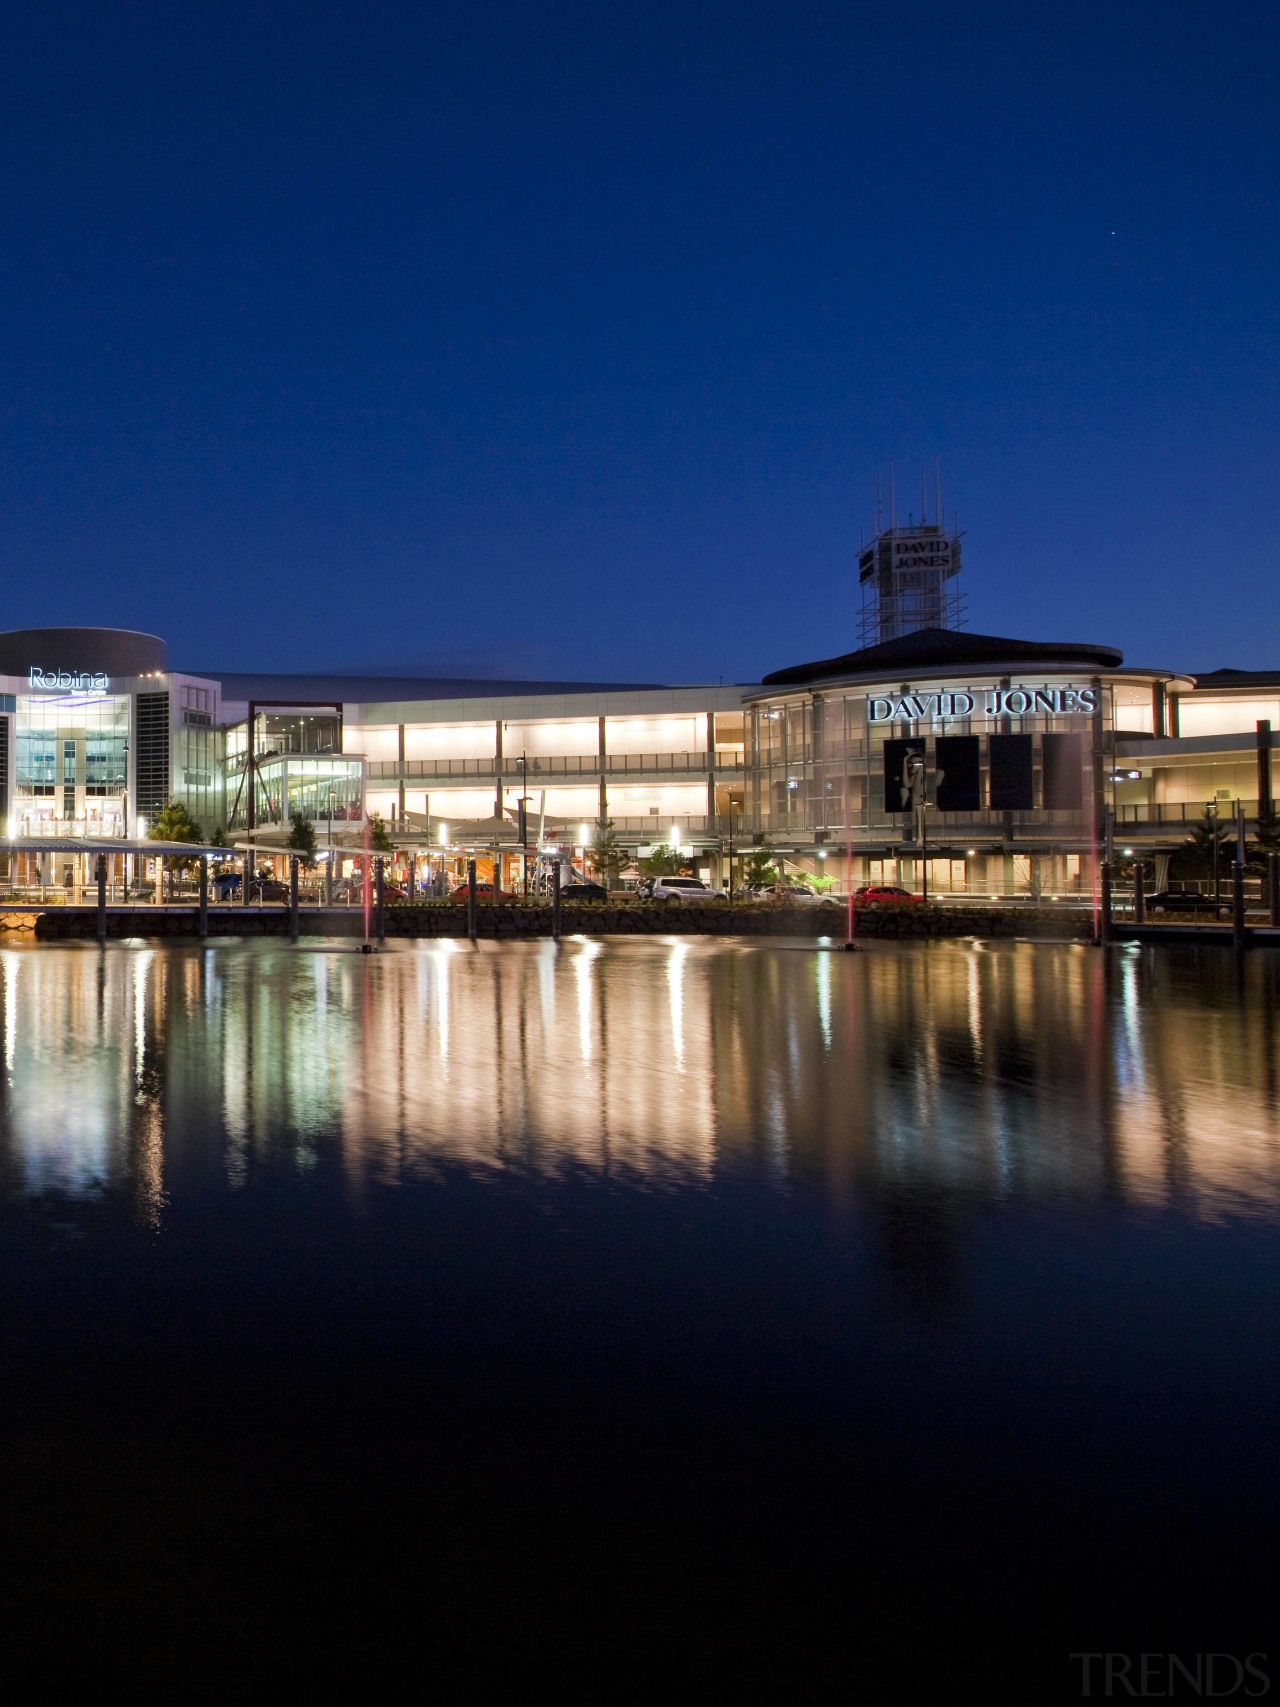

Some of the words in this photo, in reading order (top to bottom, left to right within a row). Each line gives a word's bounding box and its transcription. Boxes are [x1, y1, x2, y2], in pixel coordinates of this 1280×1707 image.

[896, 540, 949, 555] DAVID
[896, 555, 950, 569] JONES
[29, 666, 108, 688] Robina
[869, 692, 974, 721] DAVID
[986, 688, 1098, 715] JONES
